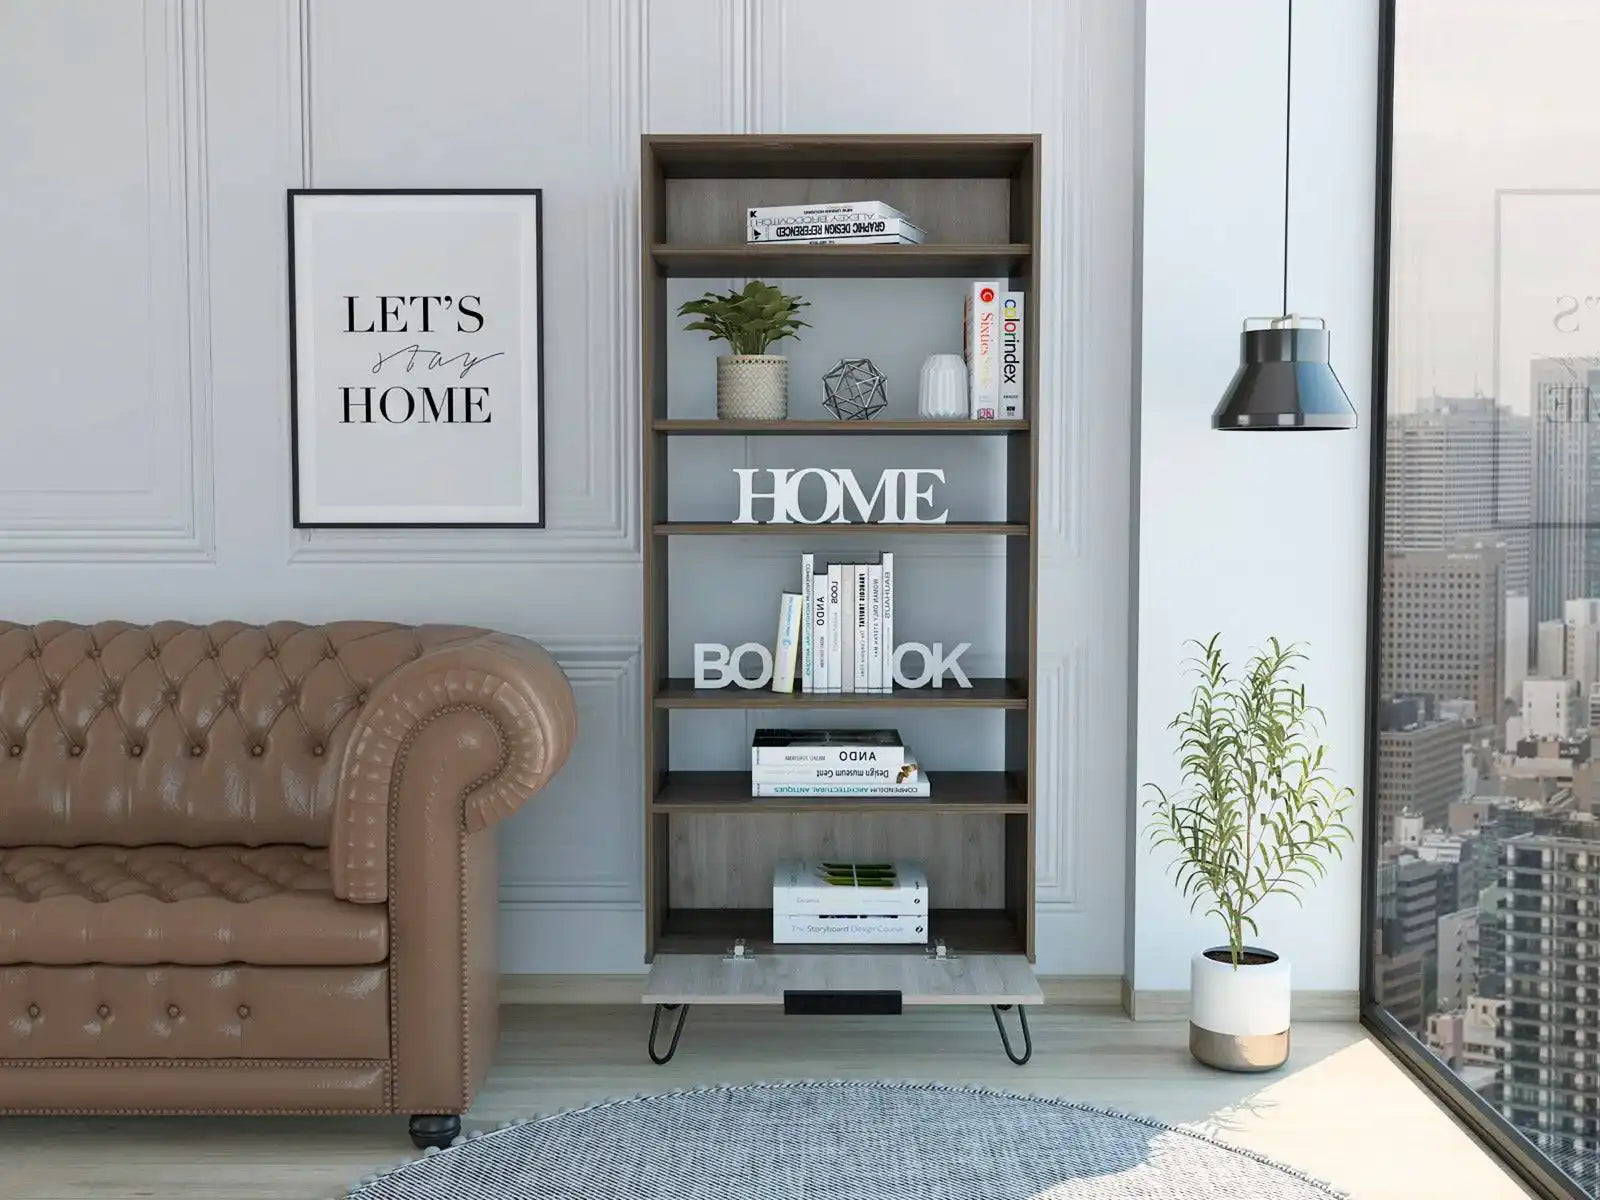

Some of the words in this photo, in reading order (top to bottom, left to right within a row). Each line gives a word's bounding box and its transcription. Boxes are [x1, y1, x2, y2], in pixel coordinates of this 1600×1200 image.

[776, 224, 823, 237] REFERENCED
[824, 222, 851, 235] DESIGN
[852, 221, 886, 233] GRAPHIC
[343, 295, 485, 333] LET’S
[980, 312, 993, 356] Sixties
[1003, 299, 1020, 384] colorindex
[372, 344, 505, 379] stay
[338, 386, 491, 424] HOME
[732, 468, 949, 524] HOME
[694, 642, 773, 689] BO
[892, 642, 973, 689] OK
[816, 769, 833, 778] Gent
[835, 769, 864, 777] museum
[865, 768, 889, 778] Design
[807, 925, 849, 934] Storyboard
